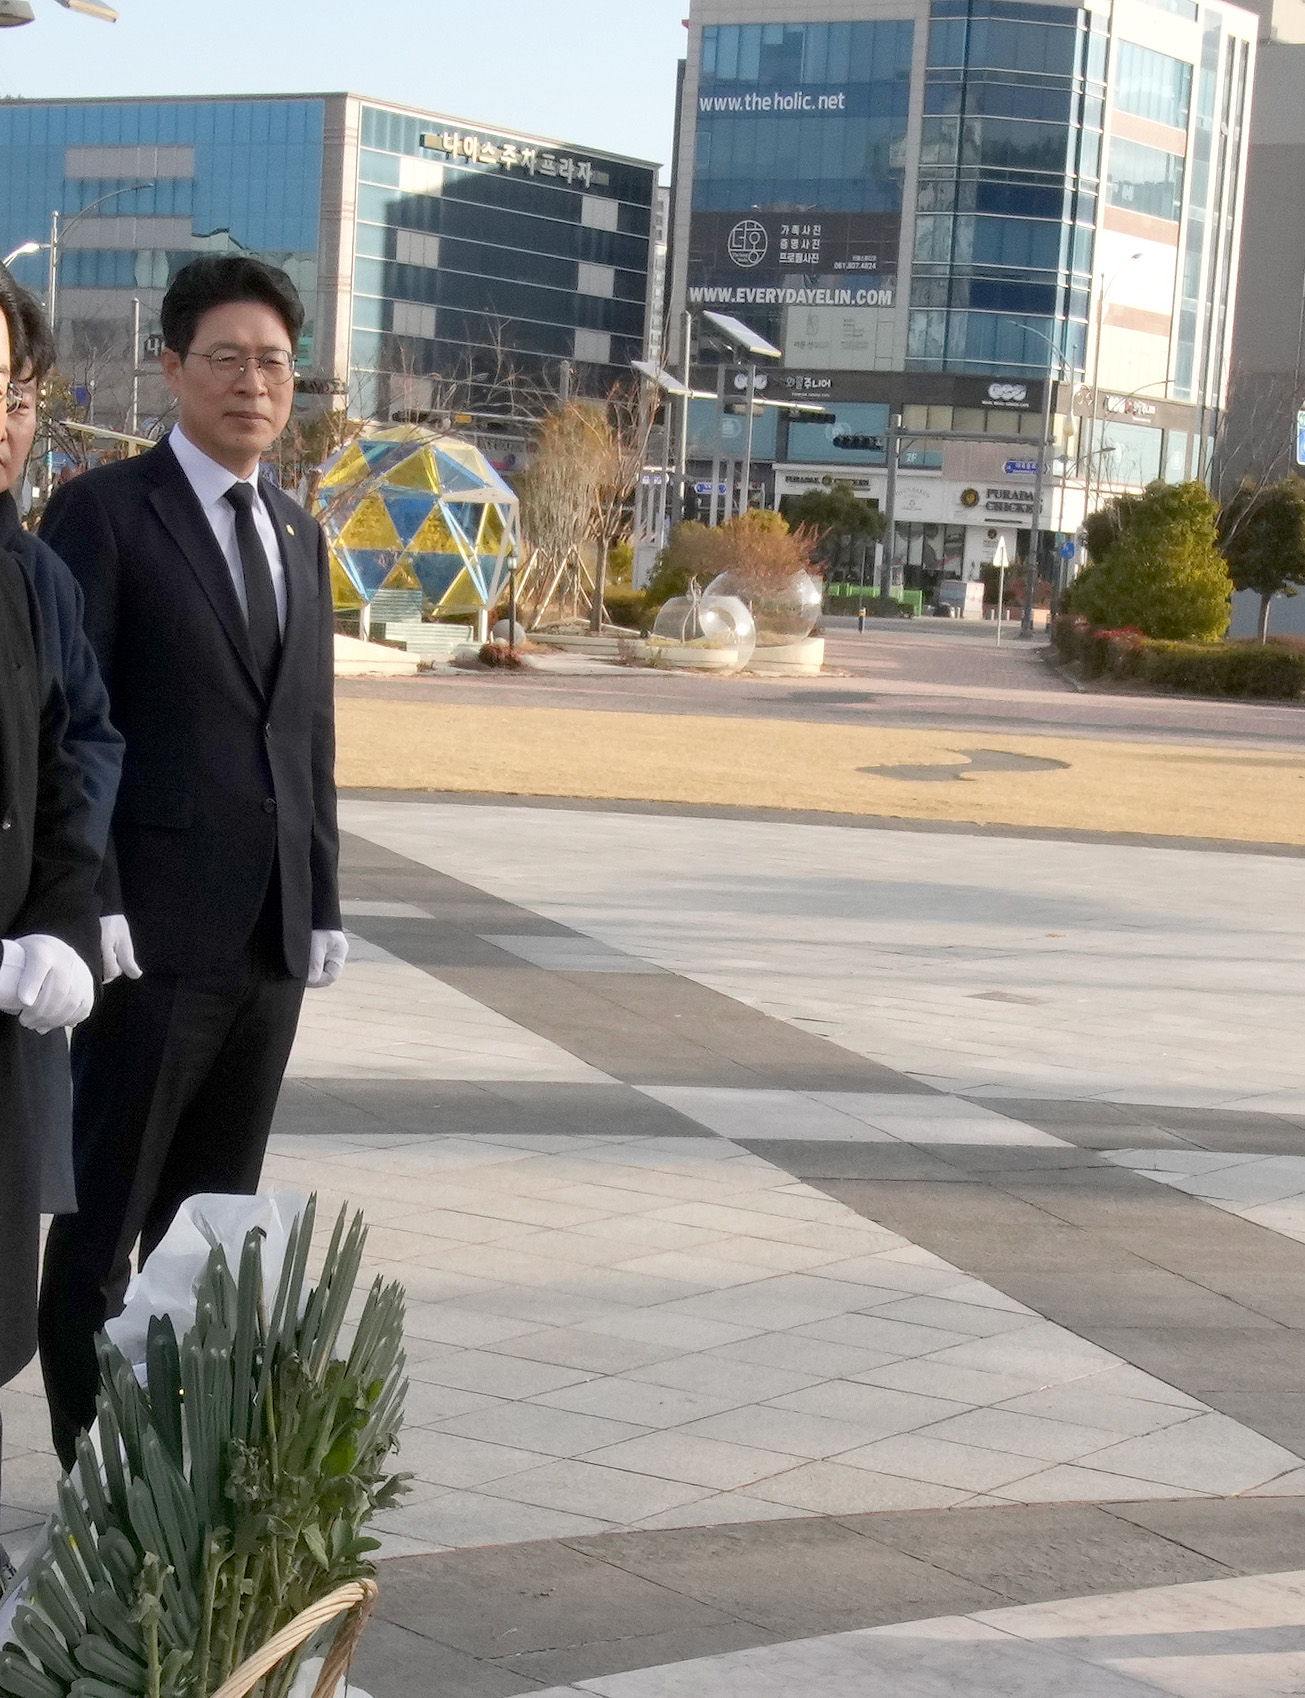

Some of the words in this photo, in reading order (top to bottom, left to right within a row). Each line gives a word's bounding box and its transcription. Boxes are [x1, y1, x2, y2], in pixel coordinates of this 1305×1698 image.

[781, 224, 822, 236] 가족사진
[779, 239, 821, 250] 증명사진
[779, 252, 820, 264] 프로필사진
[689, 286, 893, 305] WWW.EVERYDAYELIN.COM
[986, 488, 1043, 501] PURADA
